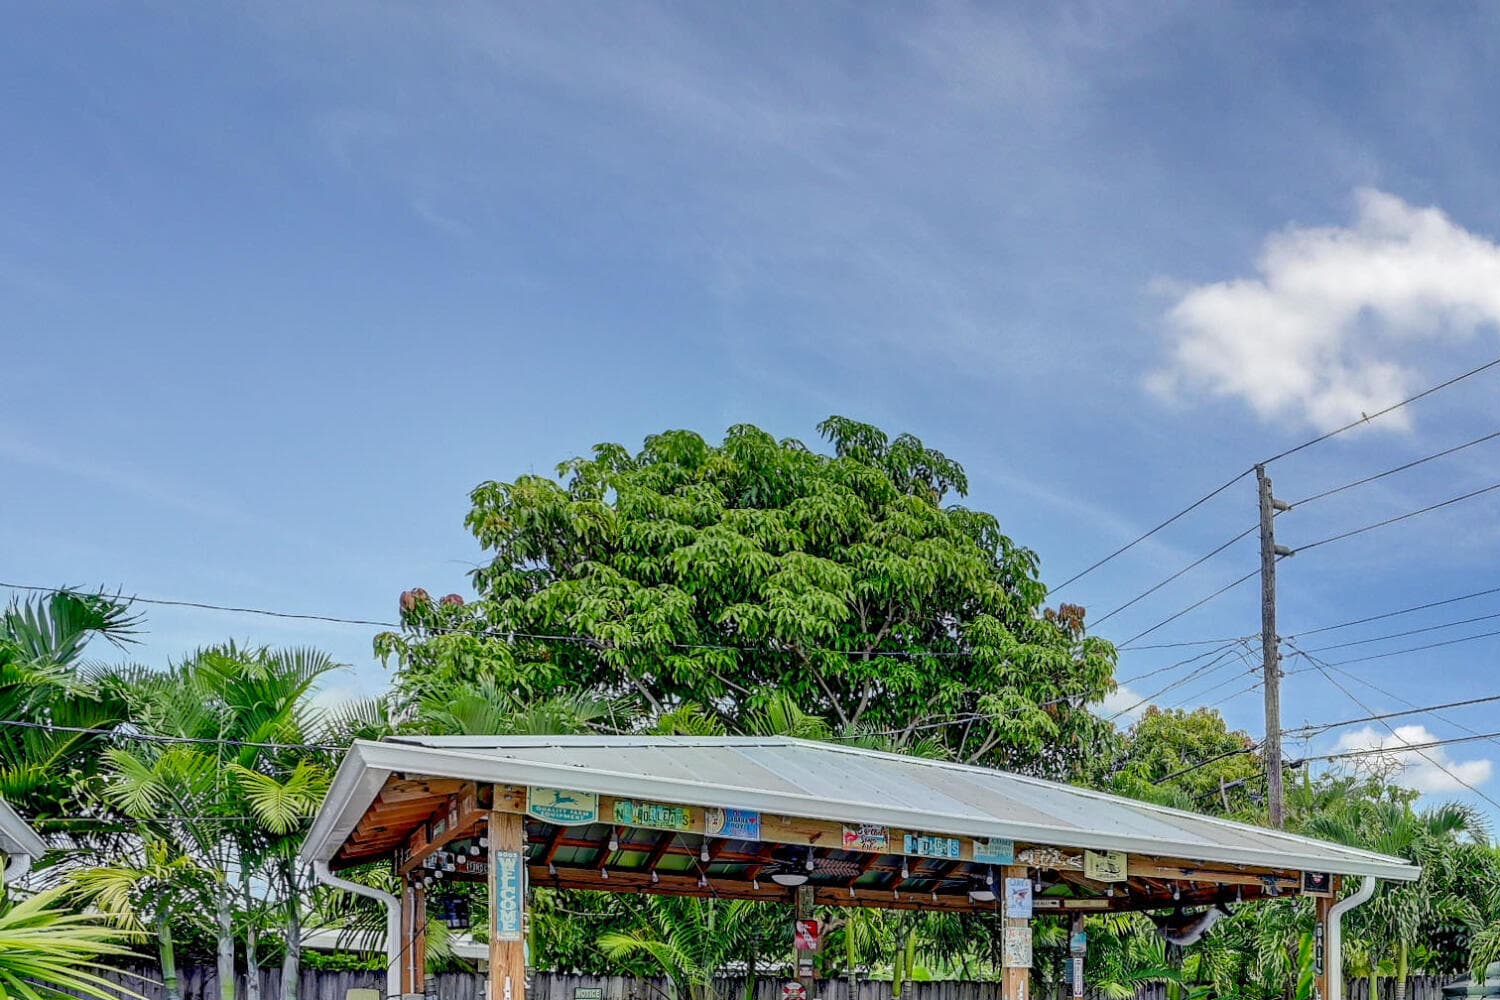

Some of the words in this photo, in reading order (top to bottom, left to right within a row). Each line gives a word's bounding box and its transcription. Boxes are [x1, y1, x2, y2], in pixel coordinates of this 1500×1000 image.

[540, 811, 585, 821] EQUIPMENT
[498, 858, 517, 932] WELCOME
[576, 990, 600, 998] NOTICE
